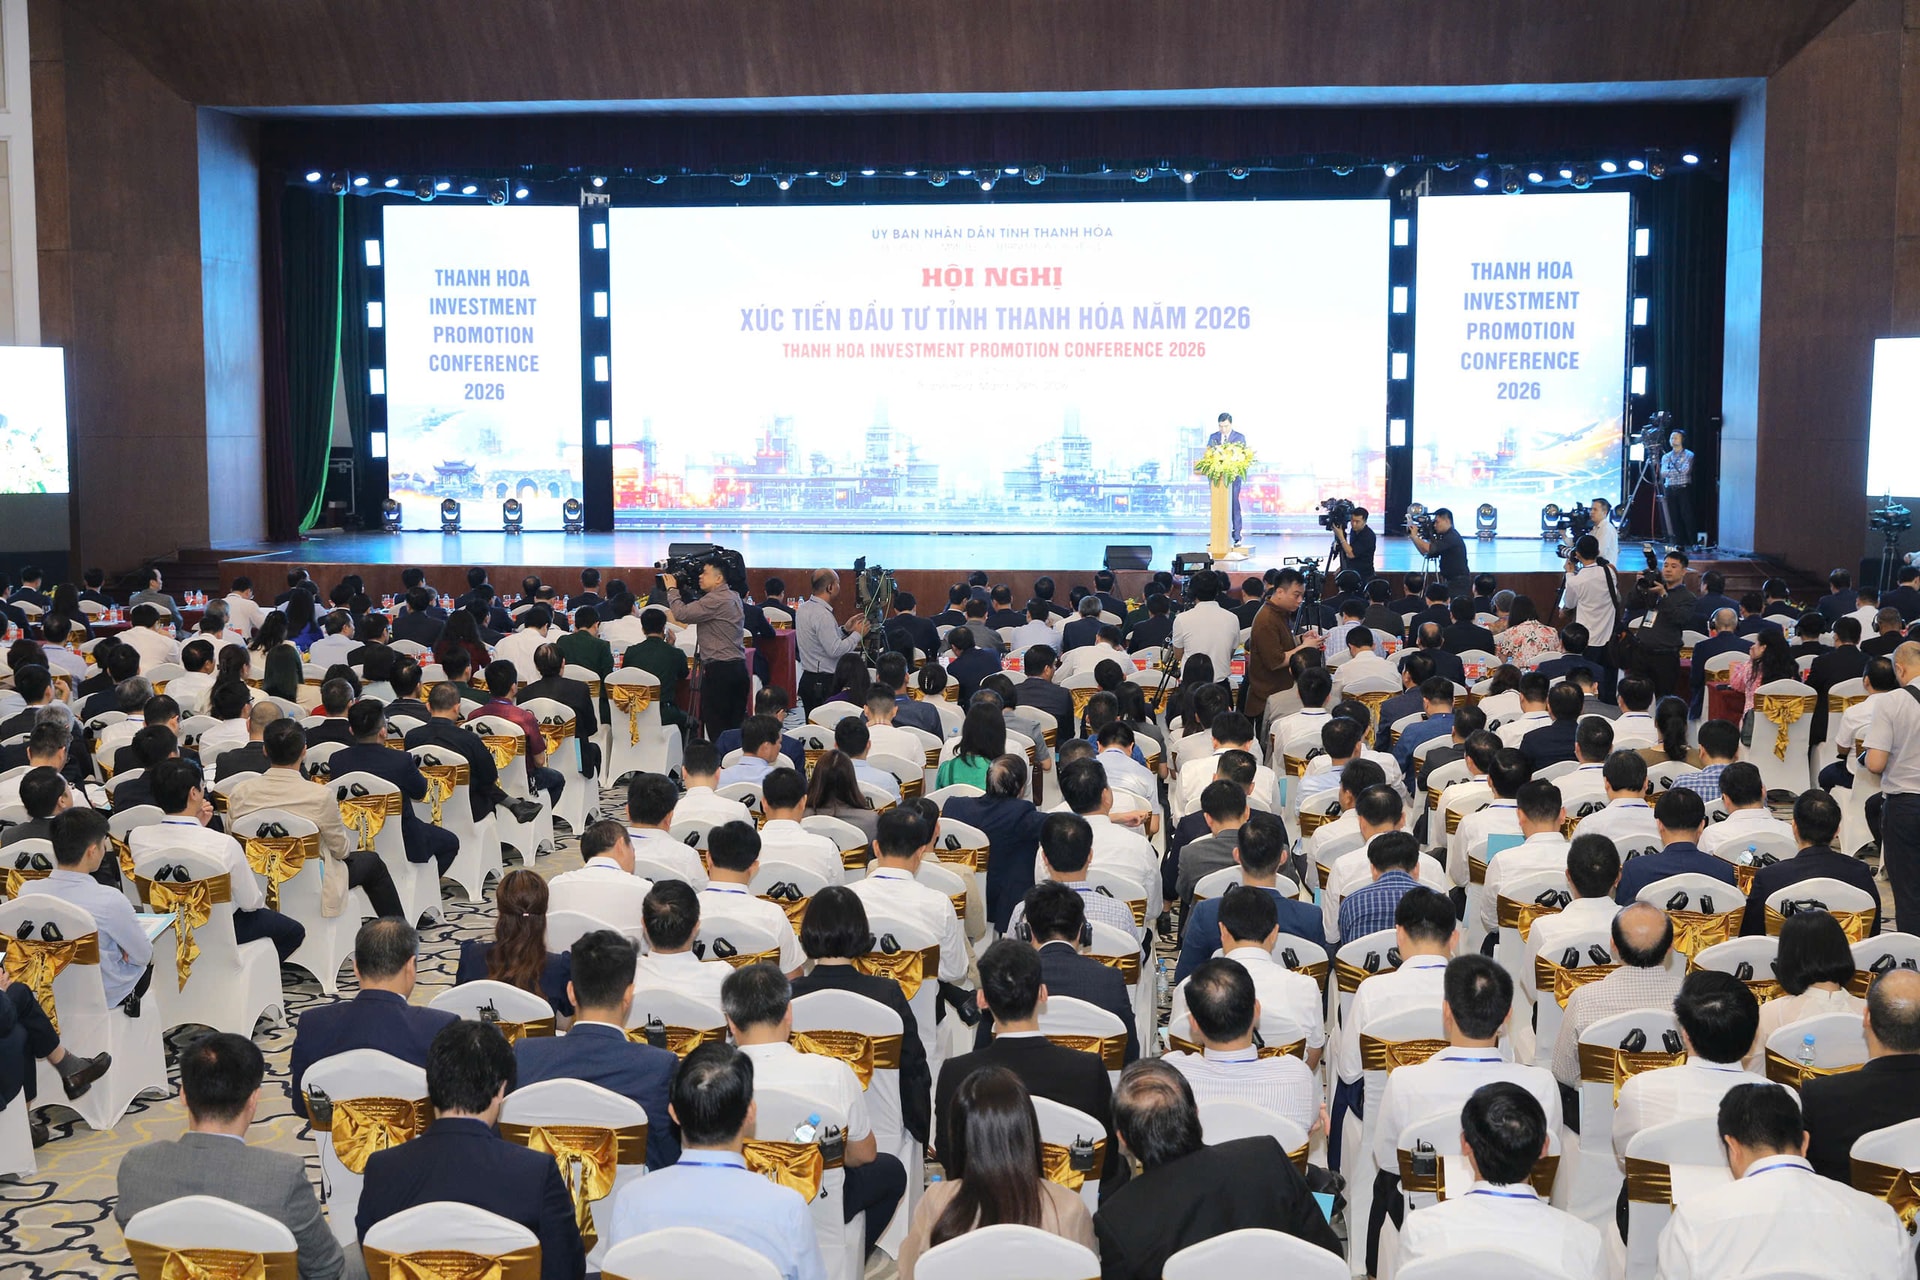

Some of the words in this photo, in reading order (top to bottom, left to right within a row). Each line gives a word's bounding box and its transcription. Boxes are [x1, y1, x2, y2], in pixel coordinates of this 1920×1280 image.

[892, 228, 920, 240] BAN
[923, 225, 963, 240] NHÂN
[966, 224, 996, 239] DÂN
[1033, 226, 1079, 239] THANH
[435, 268, 491, 288] THANH
[496, 268, 531, 288] HOA
[922, 263, 975, 292] HỘI
[985, 266, 1062, 291] NGHỊ
[1471, 262, 1531, 281] THANH
[1537, 261, 1574, 280] HOA
[429, 297, 537, 316] INVESTMENT
[1464, 291, 1580, 311] INVESTMENT
[740, 303, 785, 331] XÚC
[792, 300, 841, 331] TIẾN
[849, 299, 894, 331] ĐẦU
[902, 305, 930, 331] TƯ
[936, 299, 987, 331] TỈNH
[996, 306, 1071, 330] THANH
[1080, 301, 1124, 330] HÓA
[1132, 301, 1187, 330] NĂM
[1194, 305, 1251, 330] 2026
[434, 325, 534, 344] PROMOTION
[1467, 321, 1575, 341] PROMOTION
[783, 343, 831, 359] THANH
[836, 343, 865, 359] HOA
[870, 342, 965, 359] INVESTMENT
[970, 342, 1060, 359] PROMOTION
[1065, 342, 1164, 358] CONFERENCE
[1169, 341, 1206, 358] 2026
[429, 353, 540, 373] CONFERENCE
[1461, 351, 1580, 371] CONFERENCE
[465, 382, 505, 401] 2026
[1497, 381, 1542, 401] 2026
